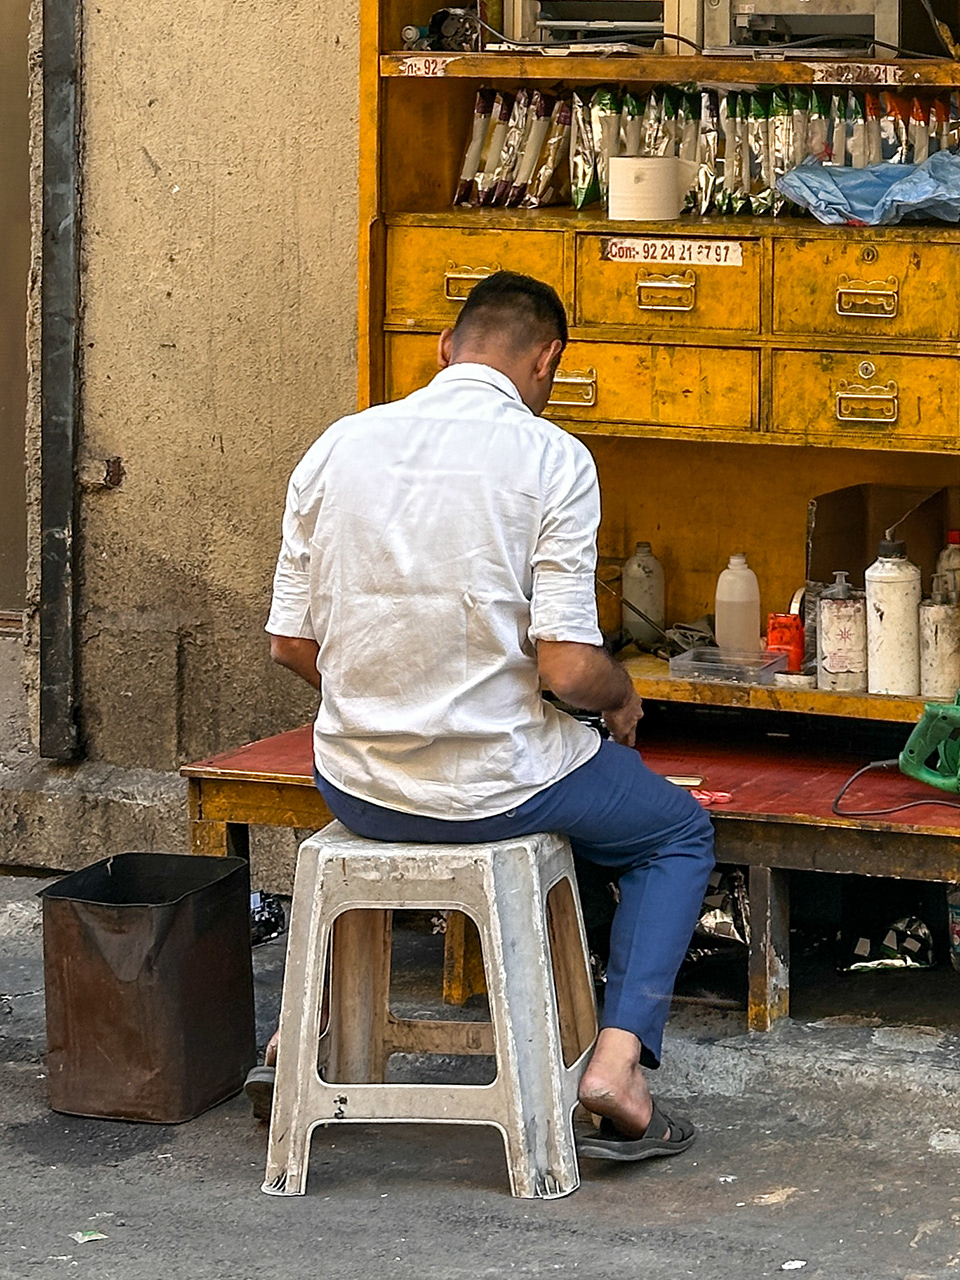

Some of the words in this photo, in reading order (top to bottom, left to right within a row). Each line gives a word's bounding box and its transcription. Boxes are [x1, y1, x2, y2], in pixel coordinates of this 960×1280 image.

[643, 243, 658, 260] 92
[660, 243, 676, 261] 24
[679, 244, 692, 261] 21
